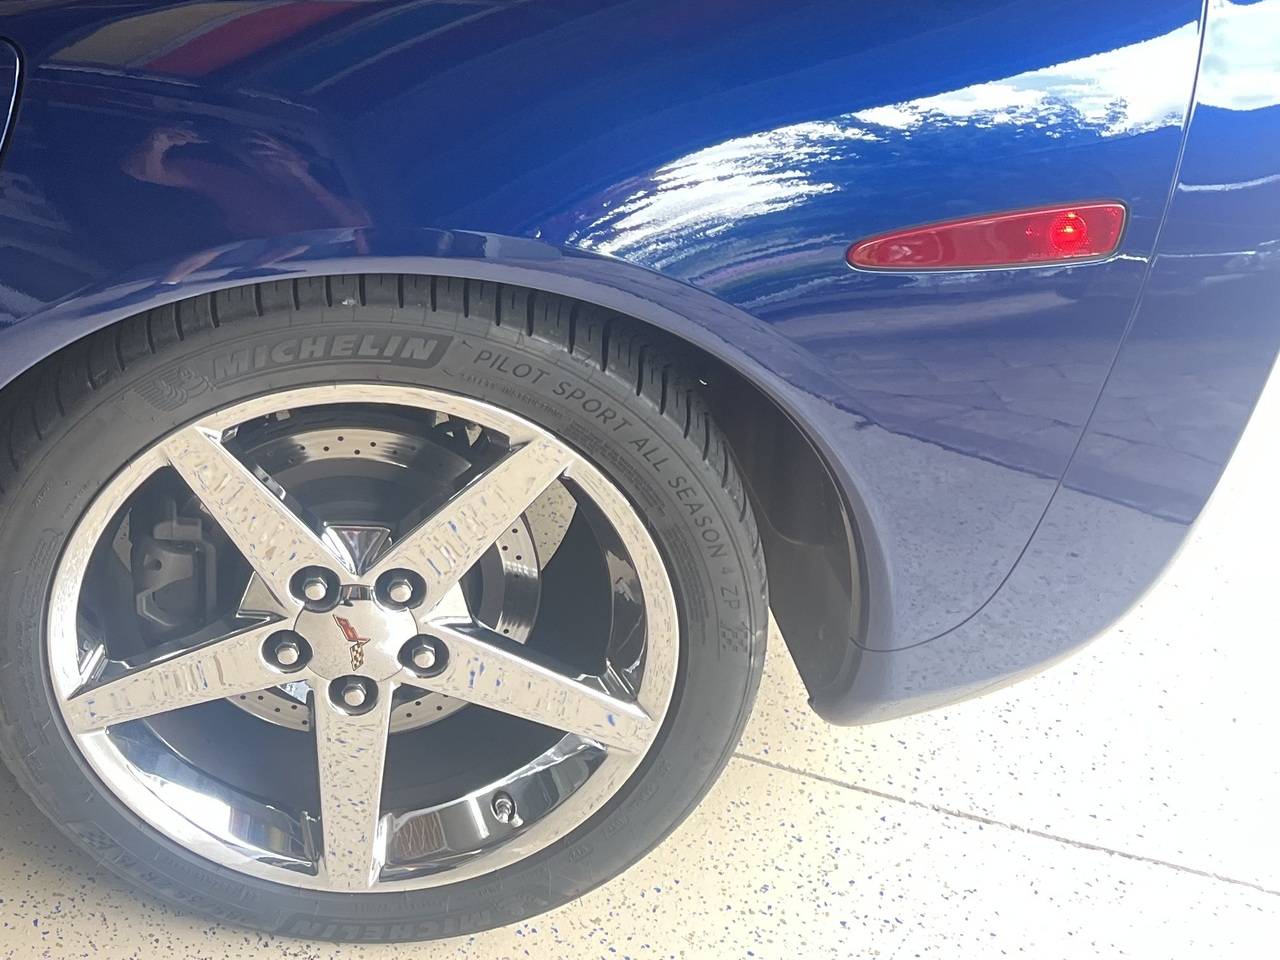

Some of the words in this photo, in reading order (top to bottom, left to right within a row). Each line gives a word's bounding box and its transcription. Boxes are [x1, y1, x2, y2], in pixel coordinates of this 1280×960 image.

[221, 333, 439, 378] MICHELIN
[473, 349, 550, 384] PILOT
[552, 381, 632, 432] SPORT
[628, 438, 669, 472] ALL
[668, 476, 727, 558] SEASON
[288, 909, 492, 941] MICHELIN
